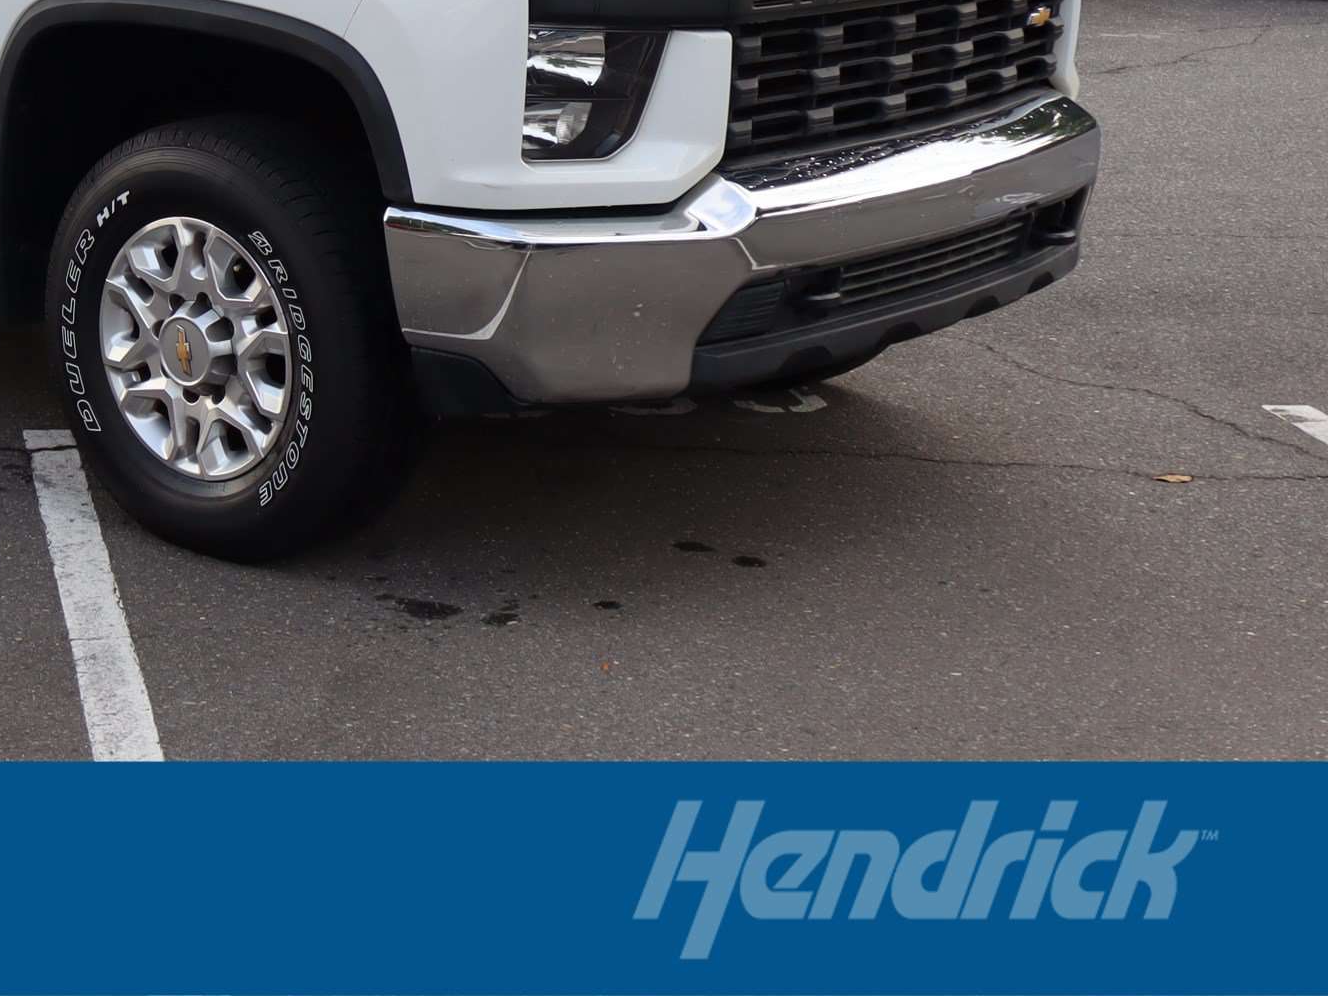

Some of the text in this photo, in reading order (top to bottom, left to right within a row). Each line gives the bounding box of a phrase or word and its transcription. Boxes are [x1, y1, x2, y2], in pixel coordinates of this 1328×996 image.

[61, 190, 130, 432] DUELER H/T
[247, 230, 314, 507] BRIDGESTONE
